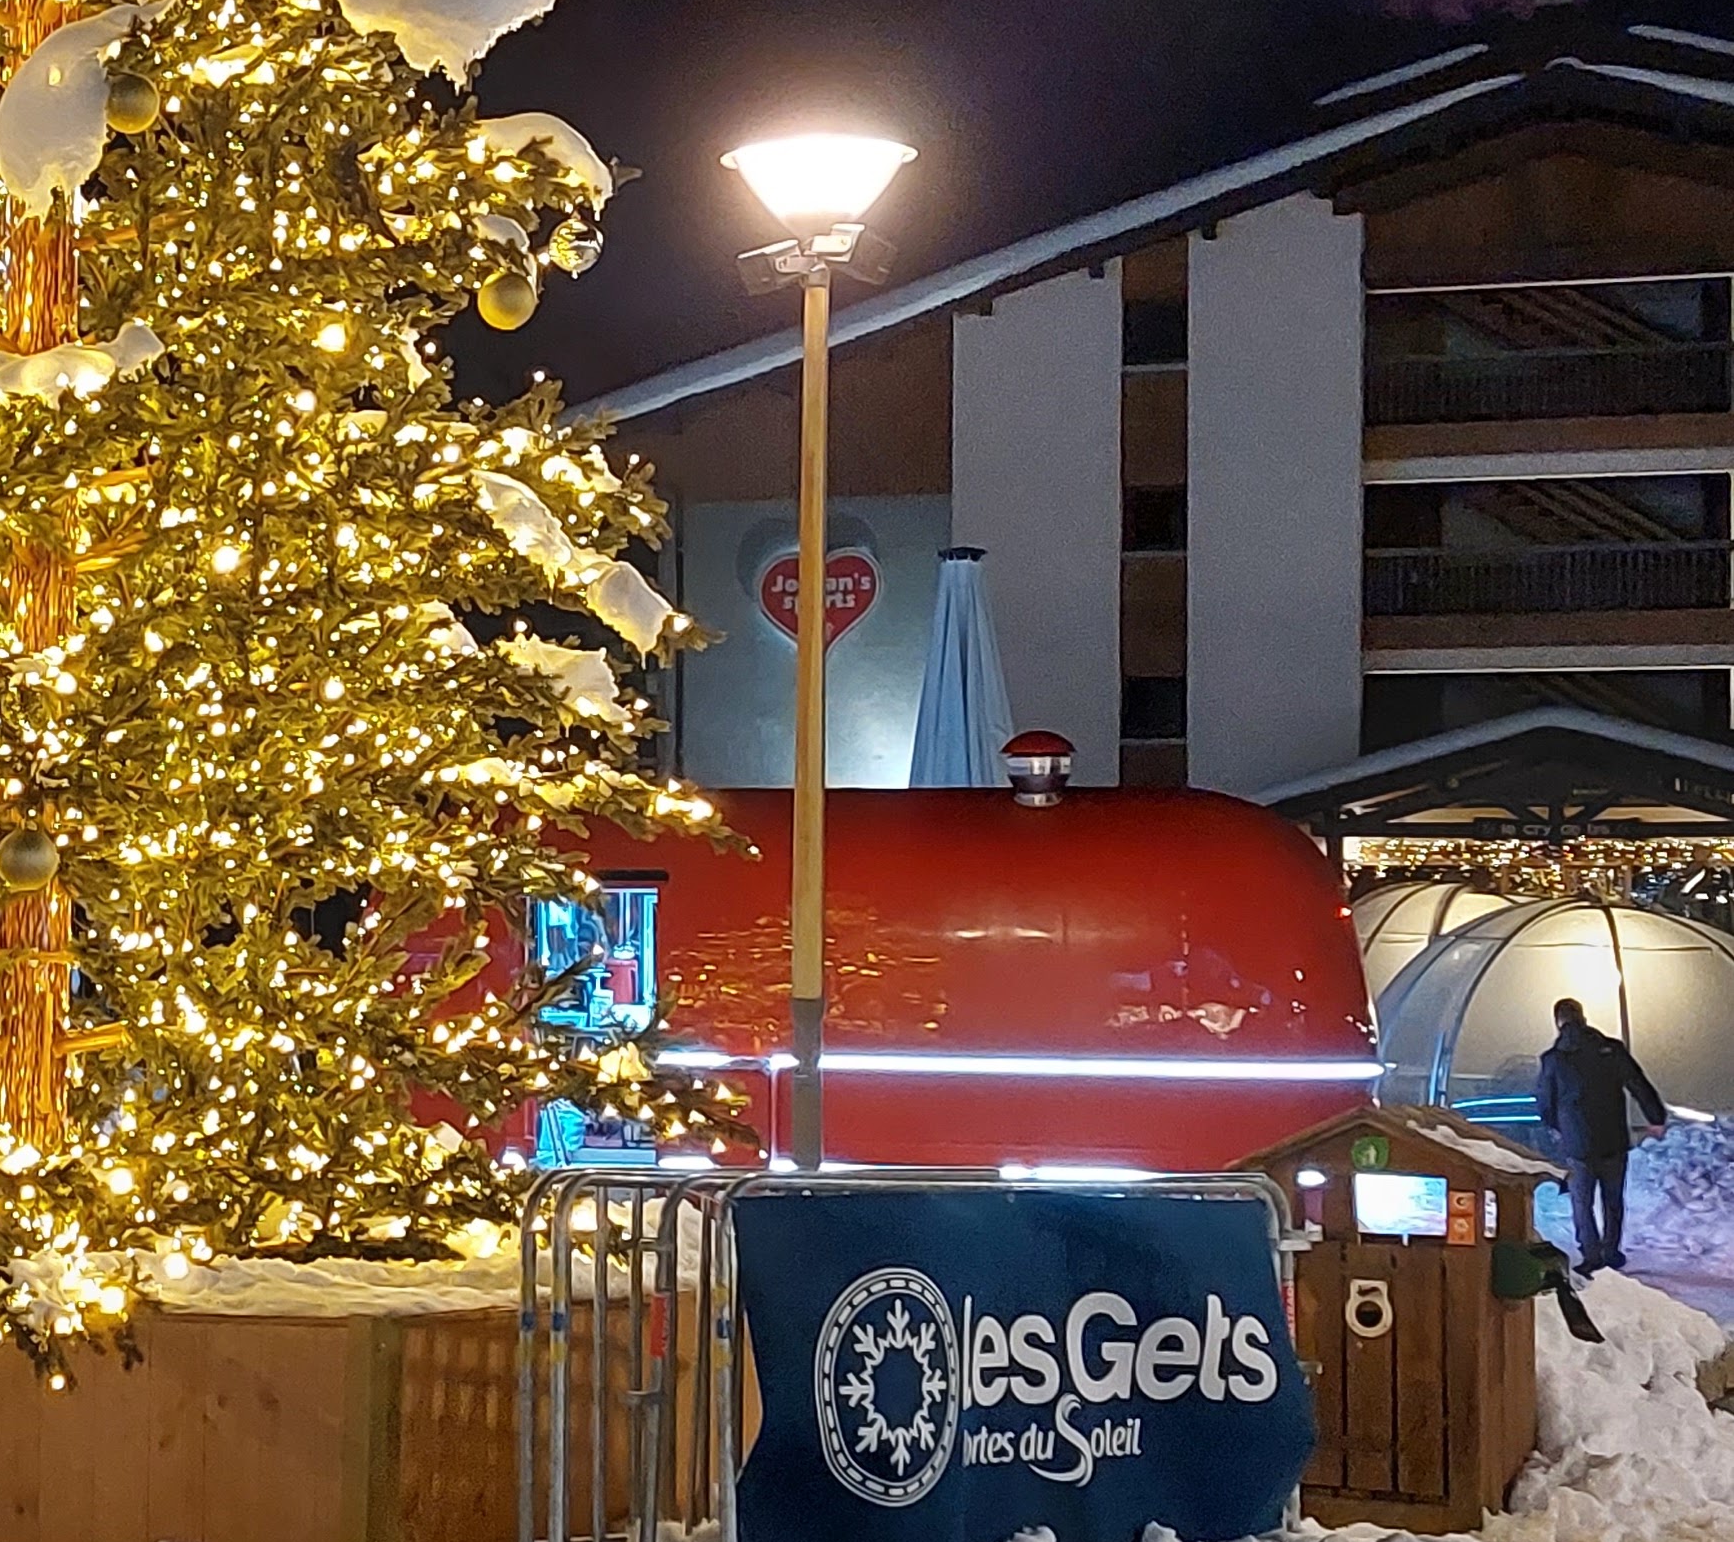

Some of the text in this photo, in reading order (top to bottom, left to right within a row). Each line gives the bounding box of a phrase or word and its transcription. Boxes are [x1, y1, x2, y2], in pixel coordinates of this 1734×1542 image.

[963, 1292, 1278, 1410] les Gets
[1020, 1423, 1055, 1460] du
[1028, 1393, 1142, 1487] Soleil
